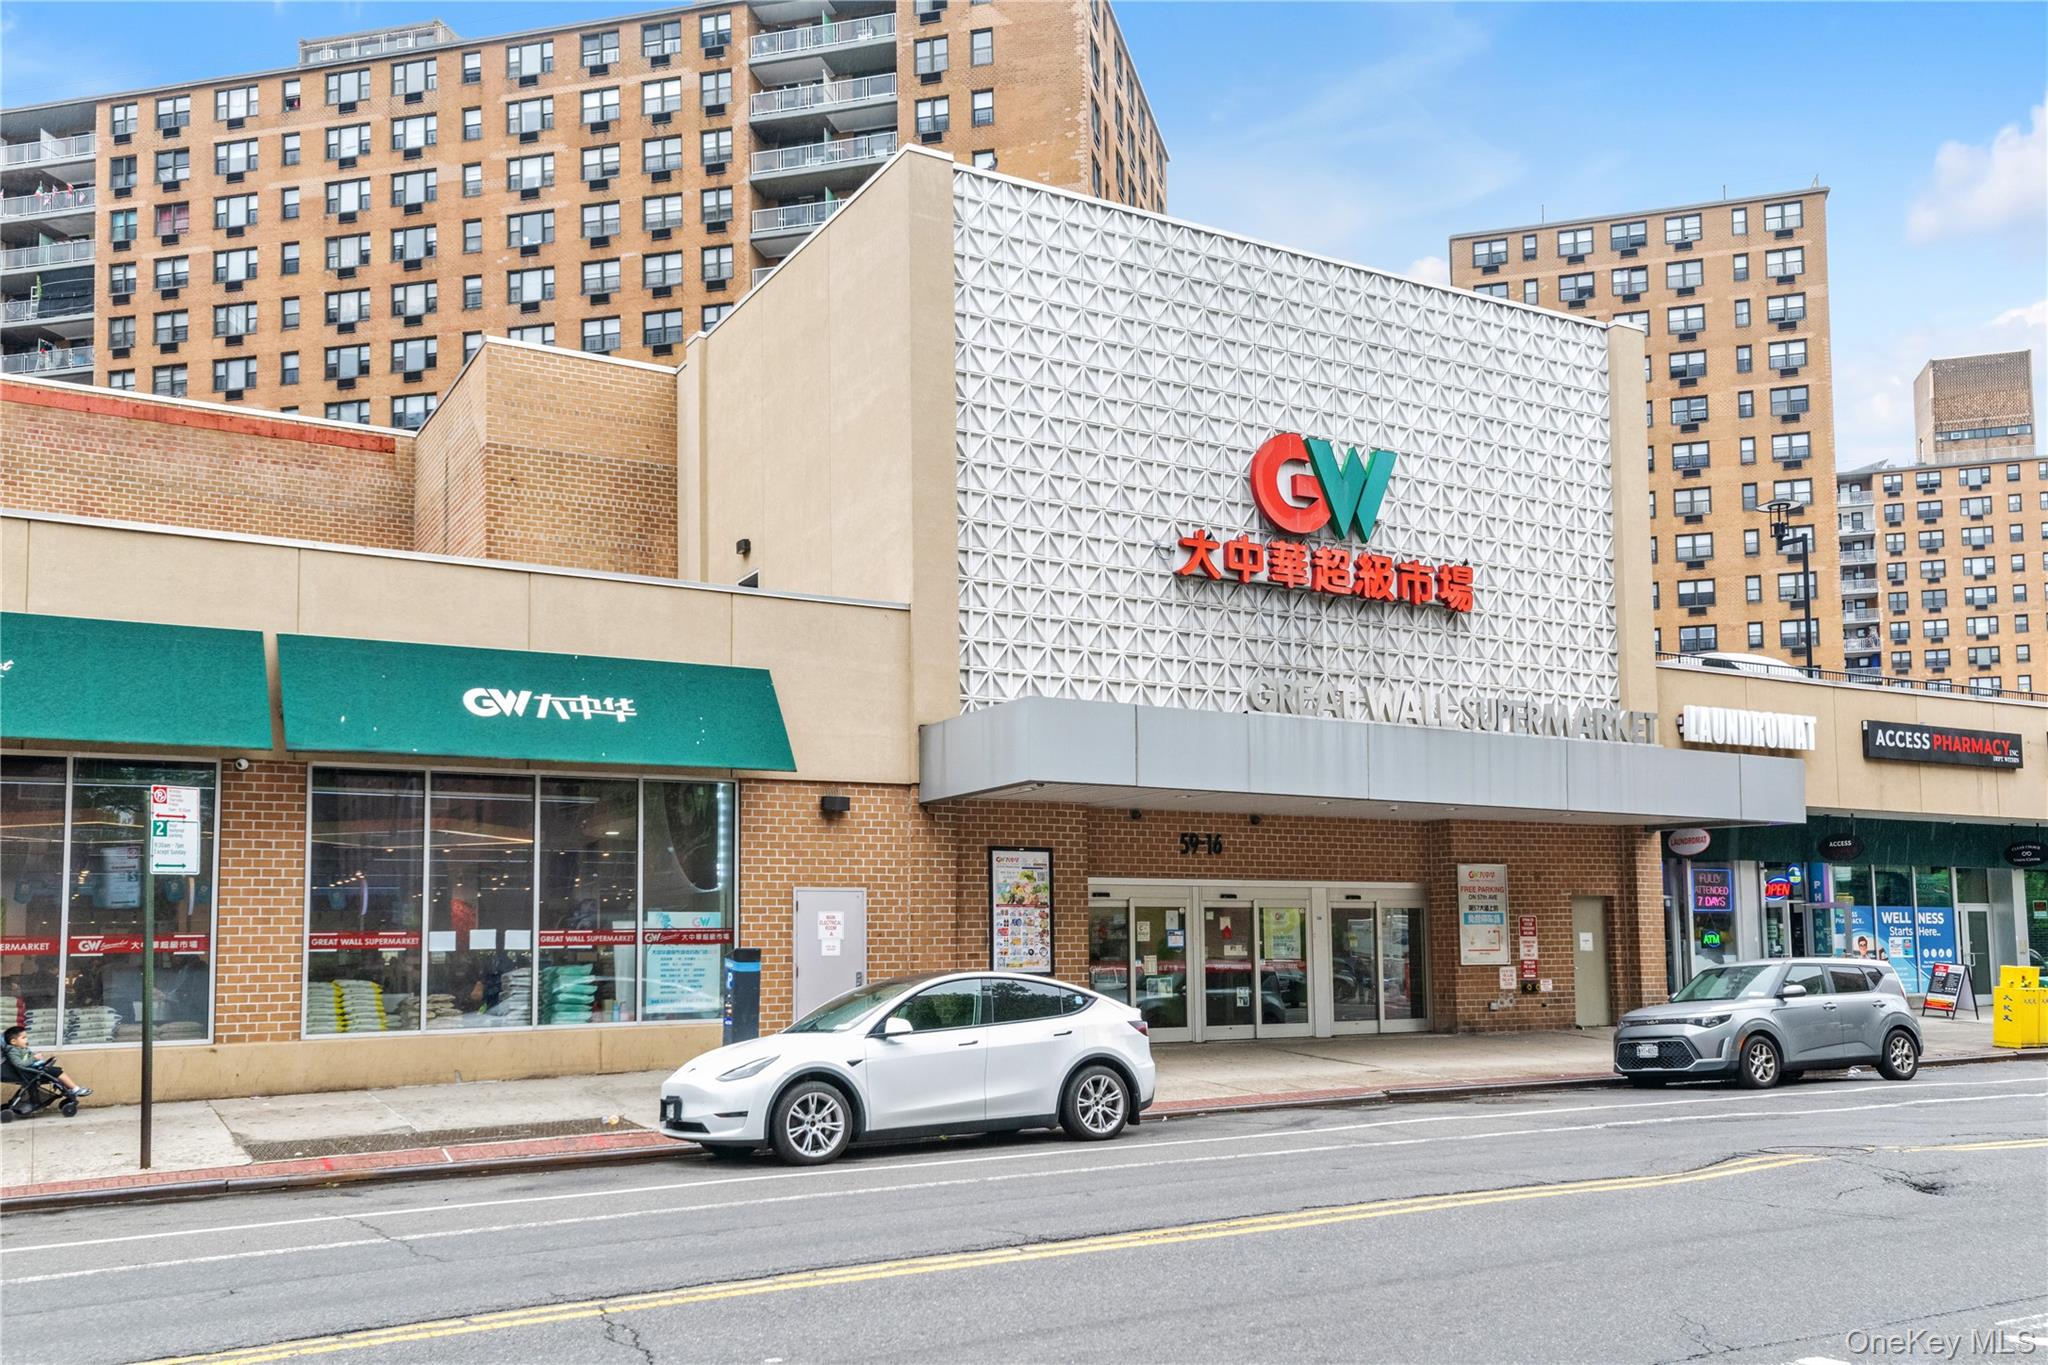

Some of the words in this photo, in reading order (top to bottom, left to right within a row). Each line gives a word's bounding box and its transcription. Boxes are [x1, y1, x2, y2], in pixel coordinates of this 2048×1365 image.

[1251, 432, 1397, 544] GW
[1175, 530, 1474, 612] 大中華超級市場
[463, 687, 532, 717] GW
[1249, 679, 1358, 720] GREAT
[1363, 686, 1458, 727] WALL
[1460, 696, 1659, 744] SUPERMARKET
[1684, 705, 1816, 750] LAUNDROMAT
[1876, 729, 1930, 749] ACCESS
[1933, 734, 2011, 756] PHARMACY
[156, 822, 164, 835] 2
[1180, 832, 1222, 855] 59-16
[1766, 883, 1791, 896] OPEN
[1697, 896, 1704, 906] 7
[1705, 897, 1726, 906] DAYS
[1889, 926, 1914, 936] Starts
[311, 938, 338, 946] GREAT
[364, 937, 420, 945] SUPERMARKET
[540, 935, 563, 943] GREAT
[566, 934, 585, 942] WALL
[587, 934, 635, 942] SUPERMARKET
[1704, 934, 1720, 944] ATM
[78, 940, 101, 951] GW
